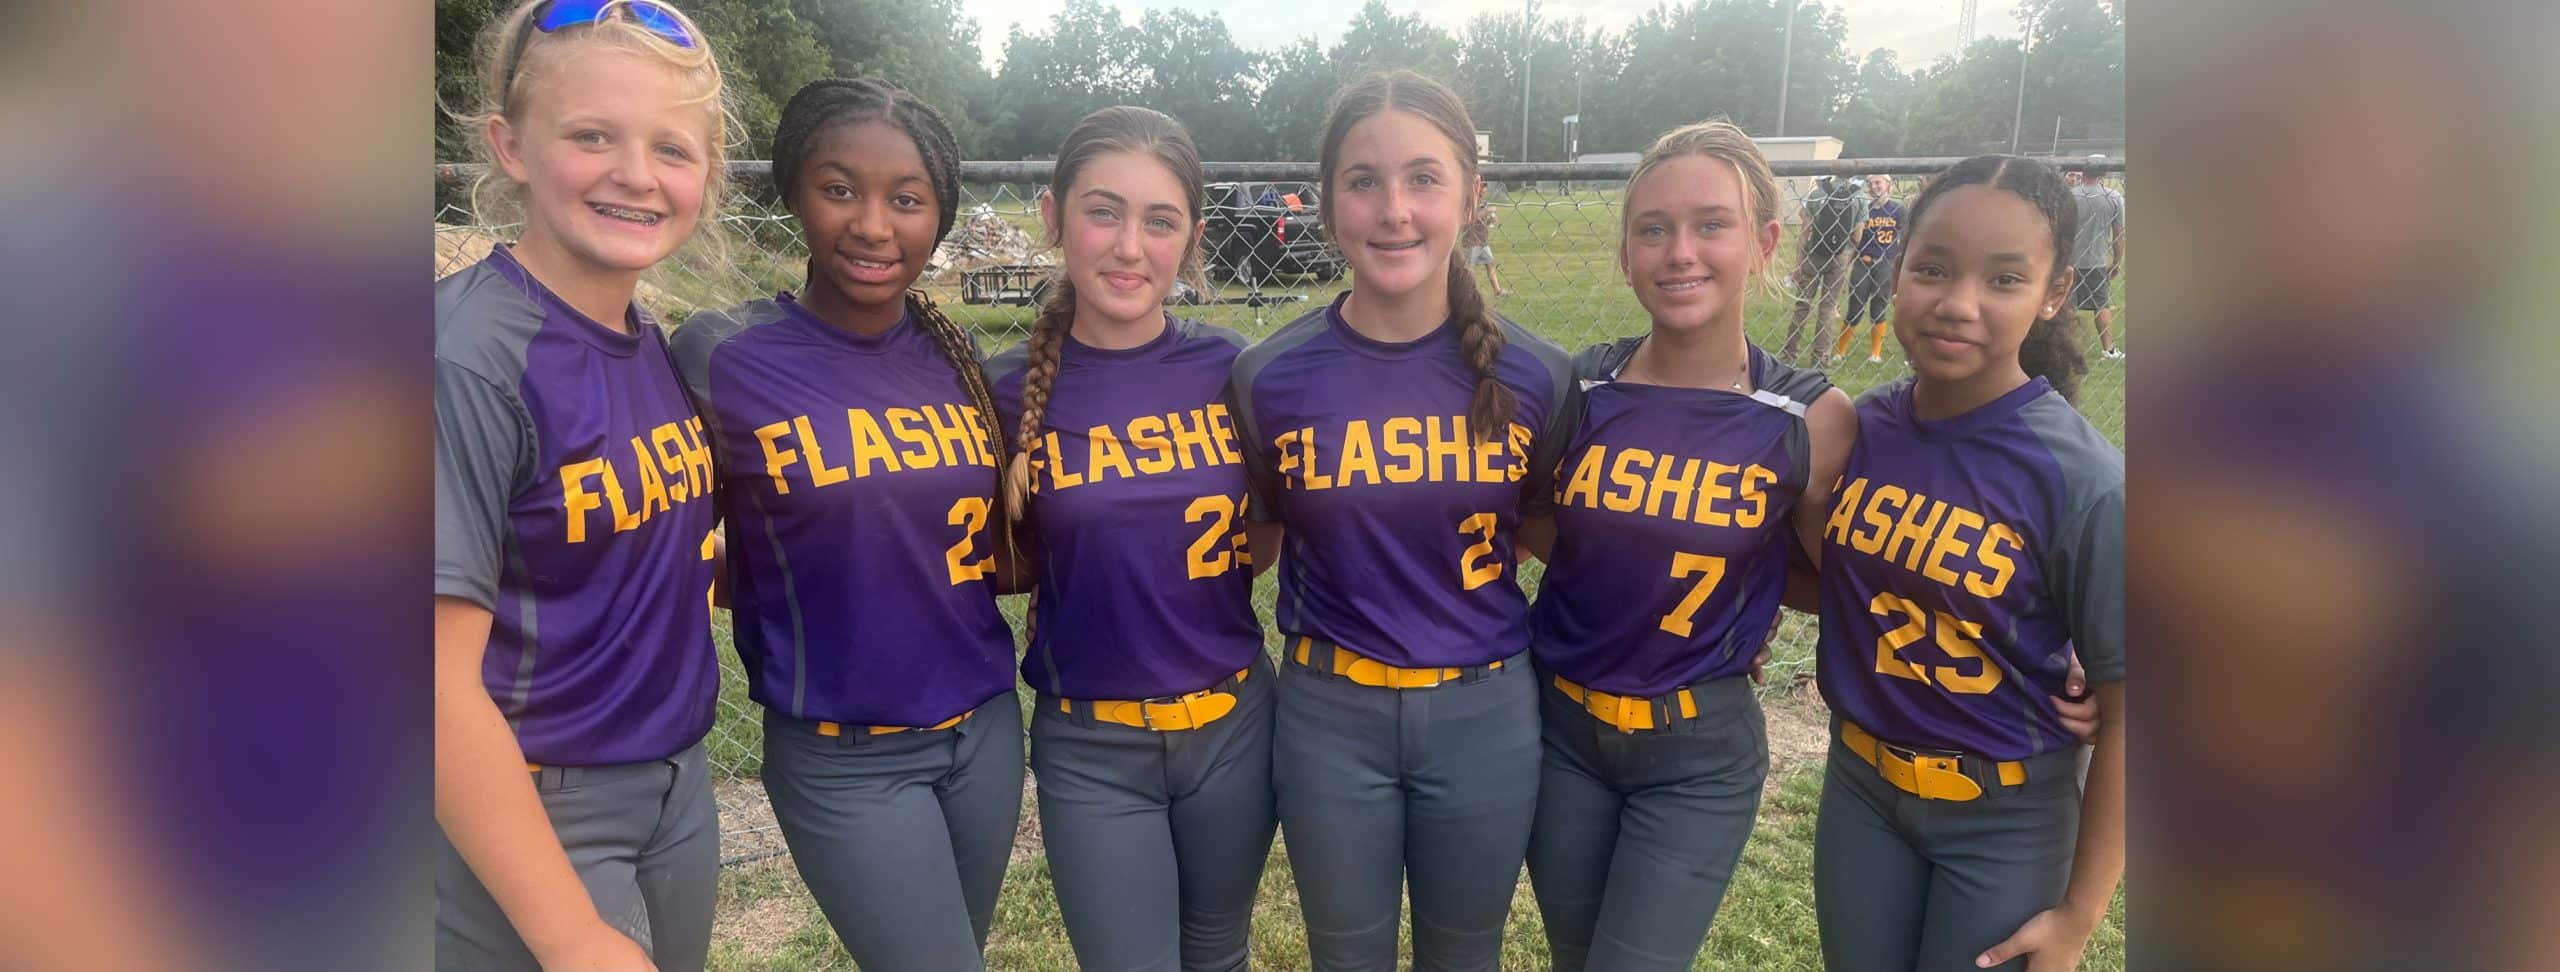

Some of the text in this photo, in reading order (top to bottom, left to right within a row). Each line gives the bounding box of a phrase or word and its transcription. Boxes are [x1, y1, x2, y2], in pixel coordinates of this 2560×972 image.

[1024, 403, 1245, 495] FLASHE
[1274, 414, 1533, 490] FLASHES
[1553, 444, 1779, 529] ASHES
[1458, 512, 1503, 591] 2
[1824, 474, 2025, 599] ASHES
[1659, 551, 1727, 638] 7
[1869, 591, 2003, 695] 25
